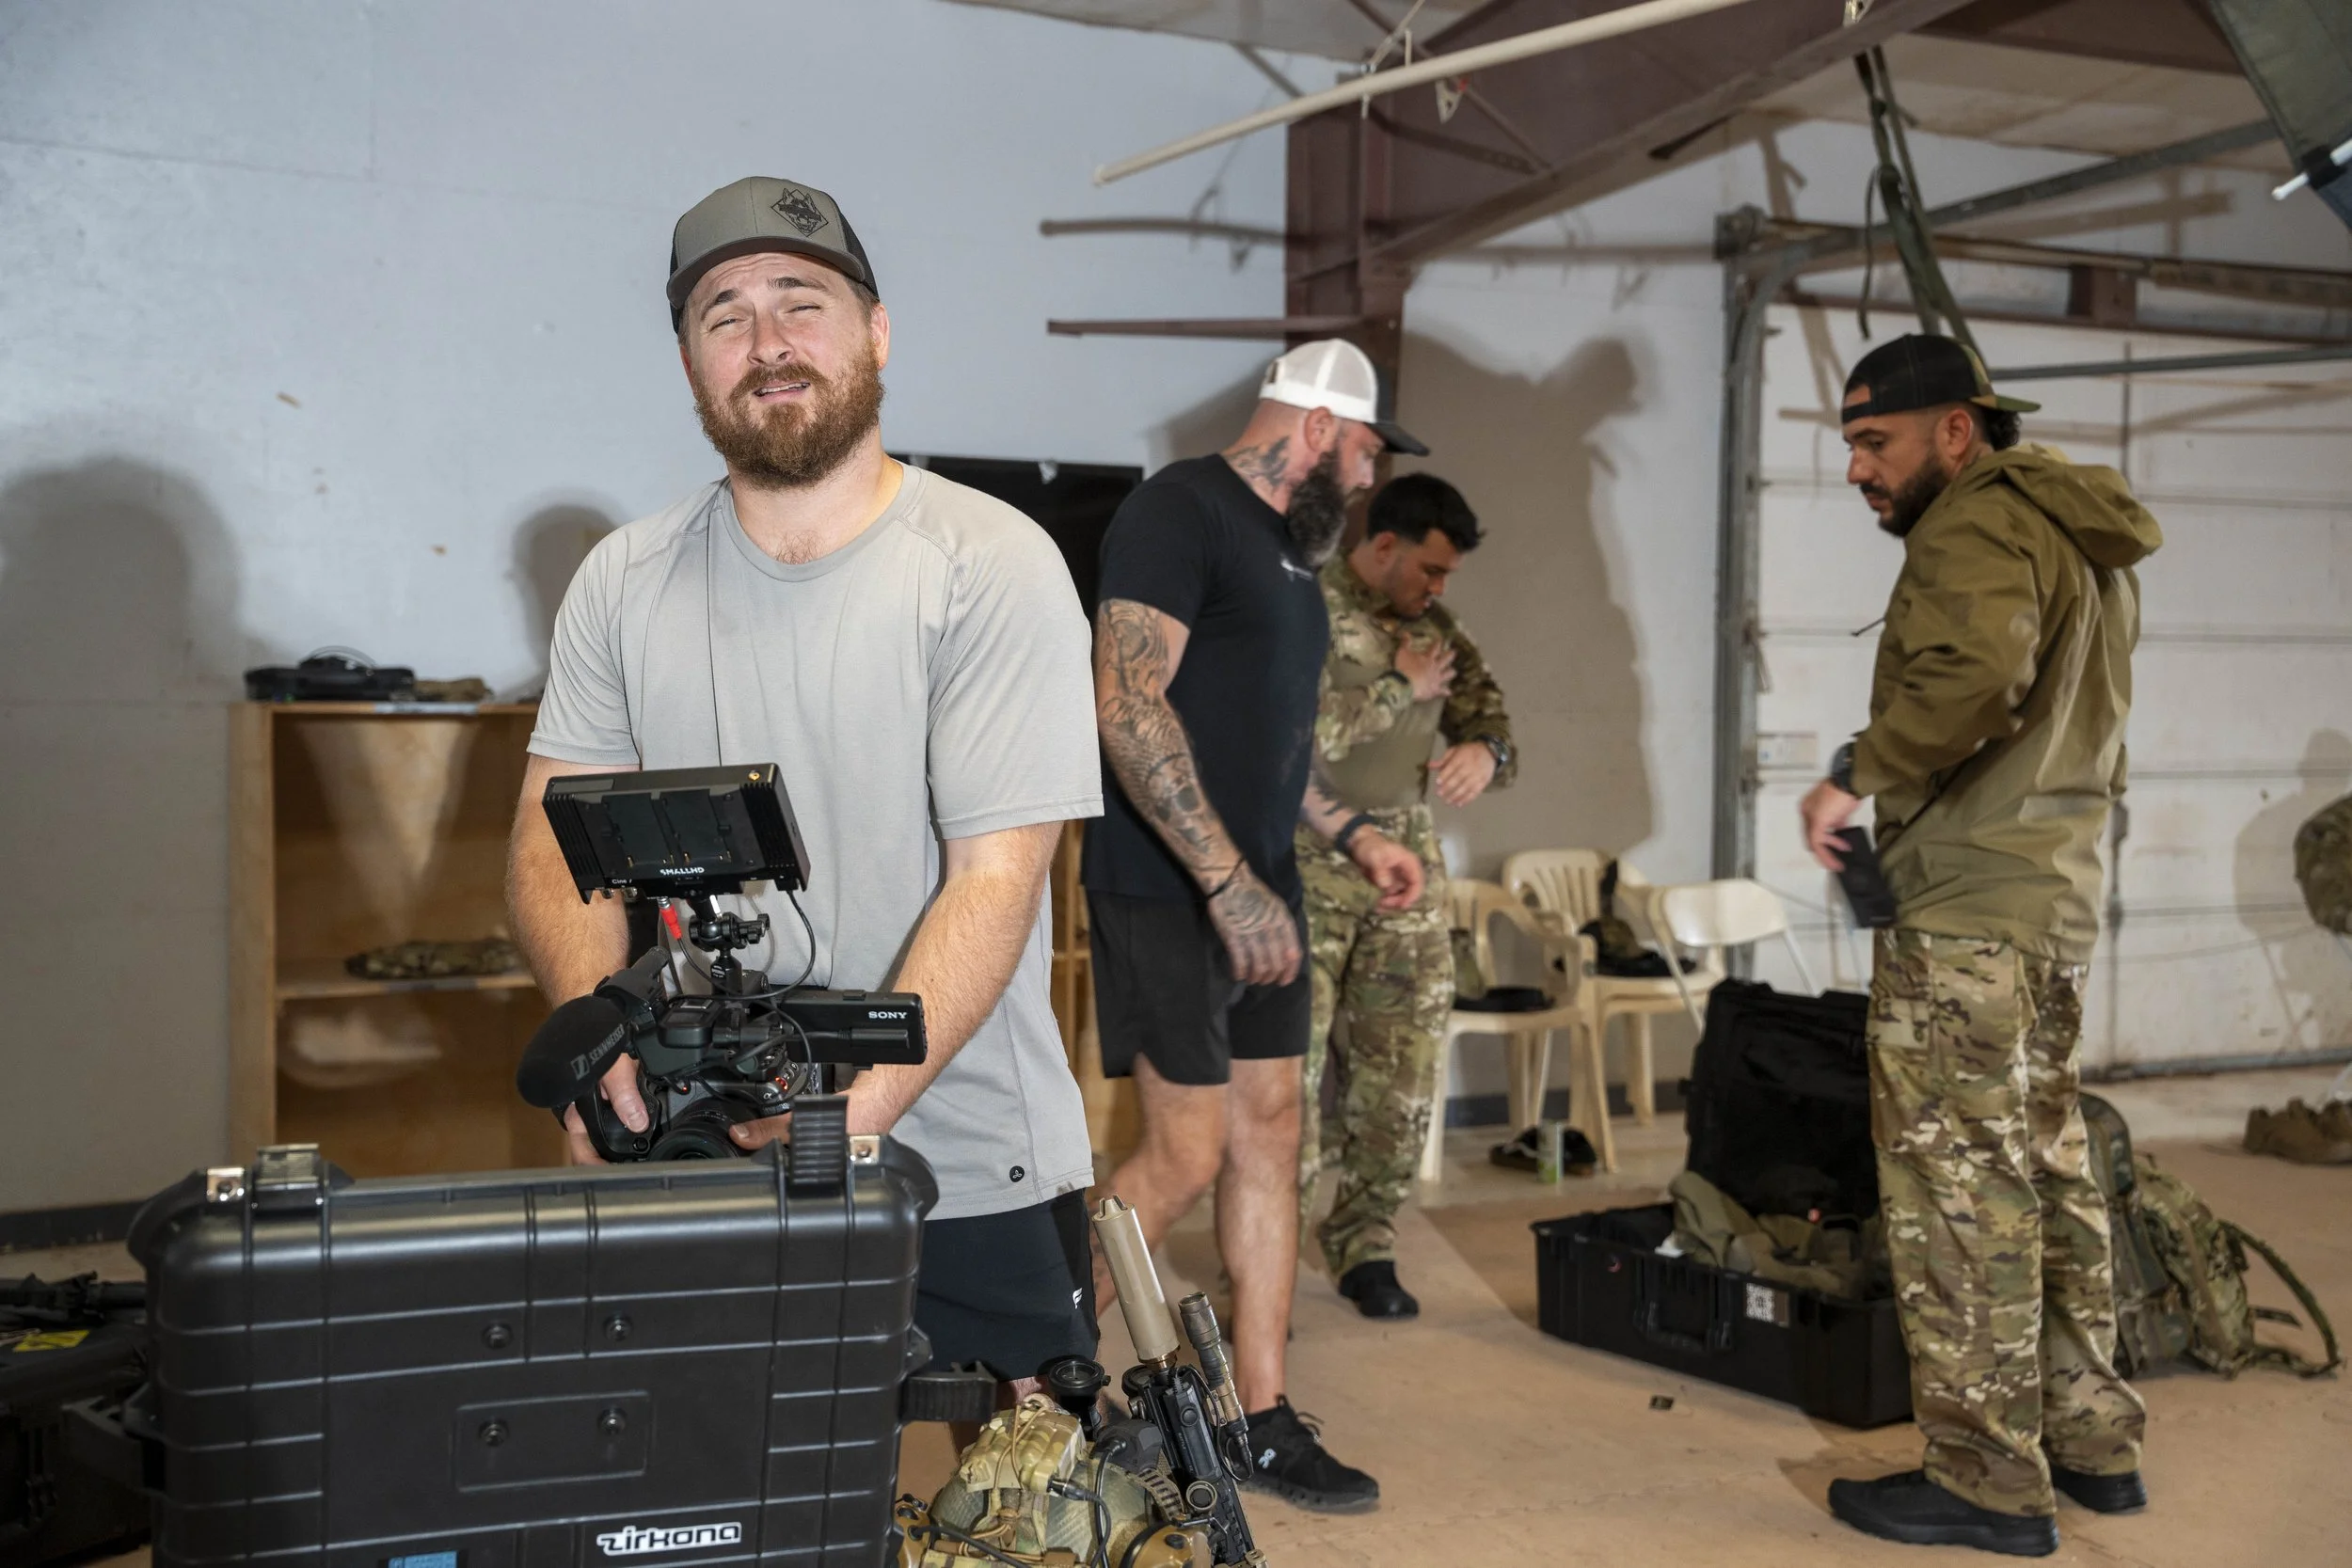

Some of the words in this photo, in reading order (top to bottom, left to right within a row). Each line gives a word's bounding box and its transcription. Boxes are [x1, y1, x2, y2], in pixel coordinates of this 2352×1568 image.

[660, 866, 705, 876] SMALLHD
[868, 1010, 908, 1020] SONY
[600, 1525, 739, 1551] zirkona
